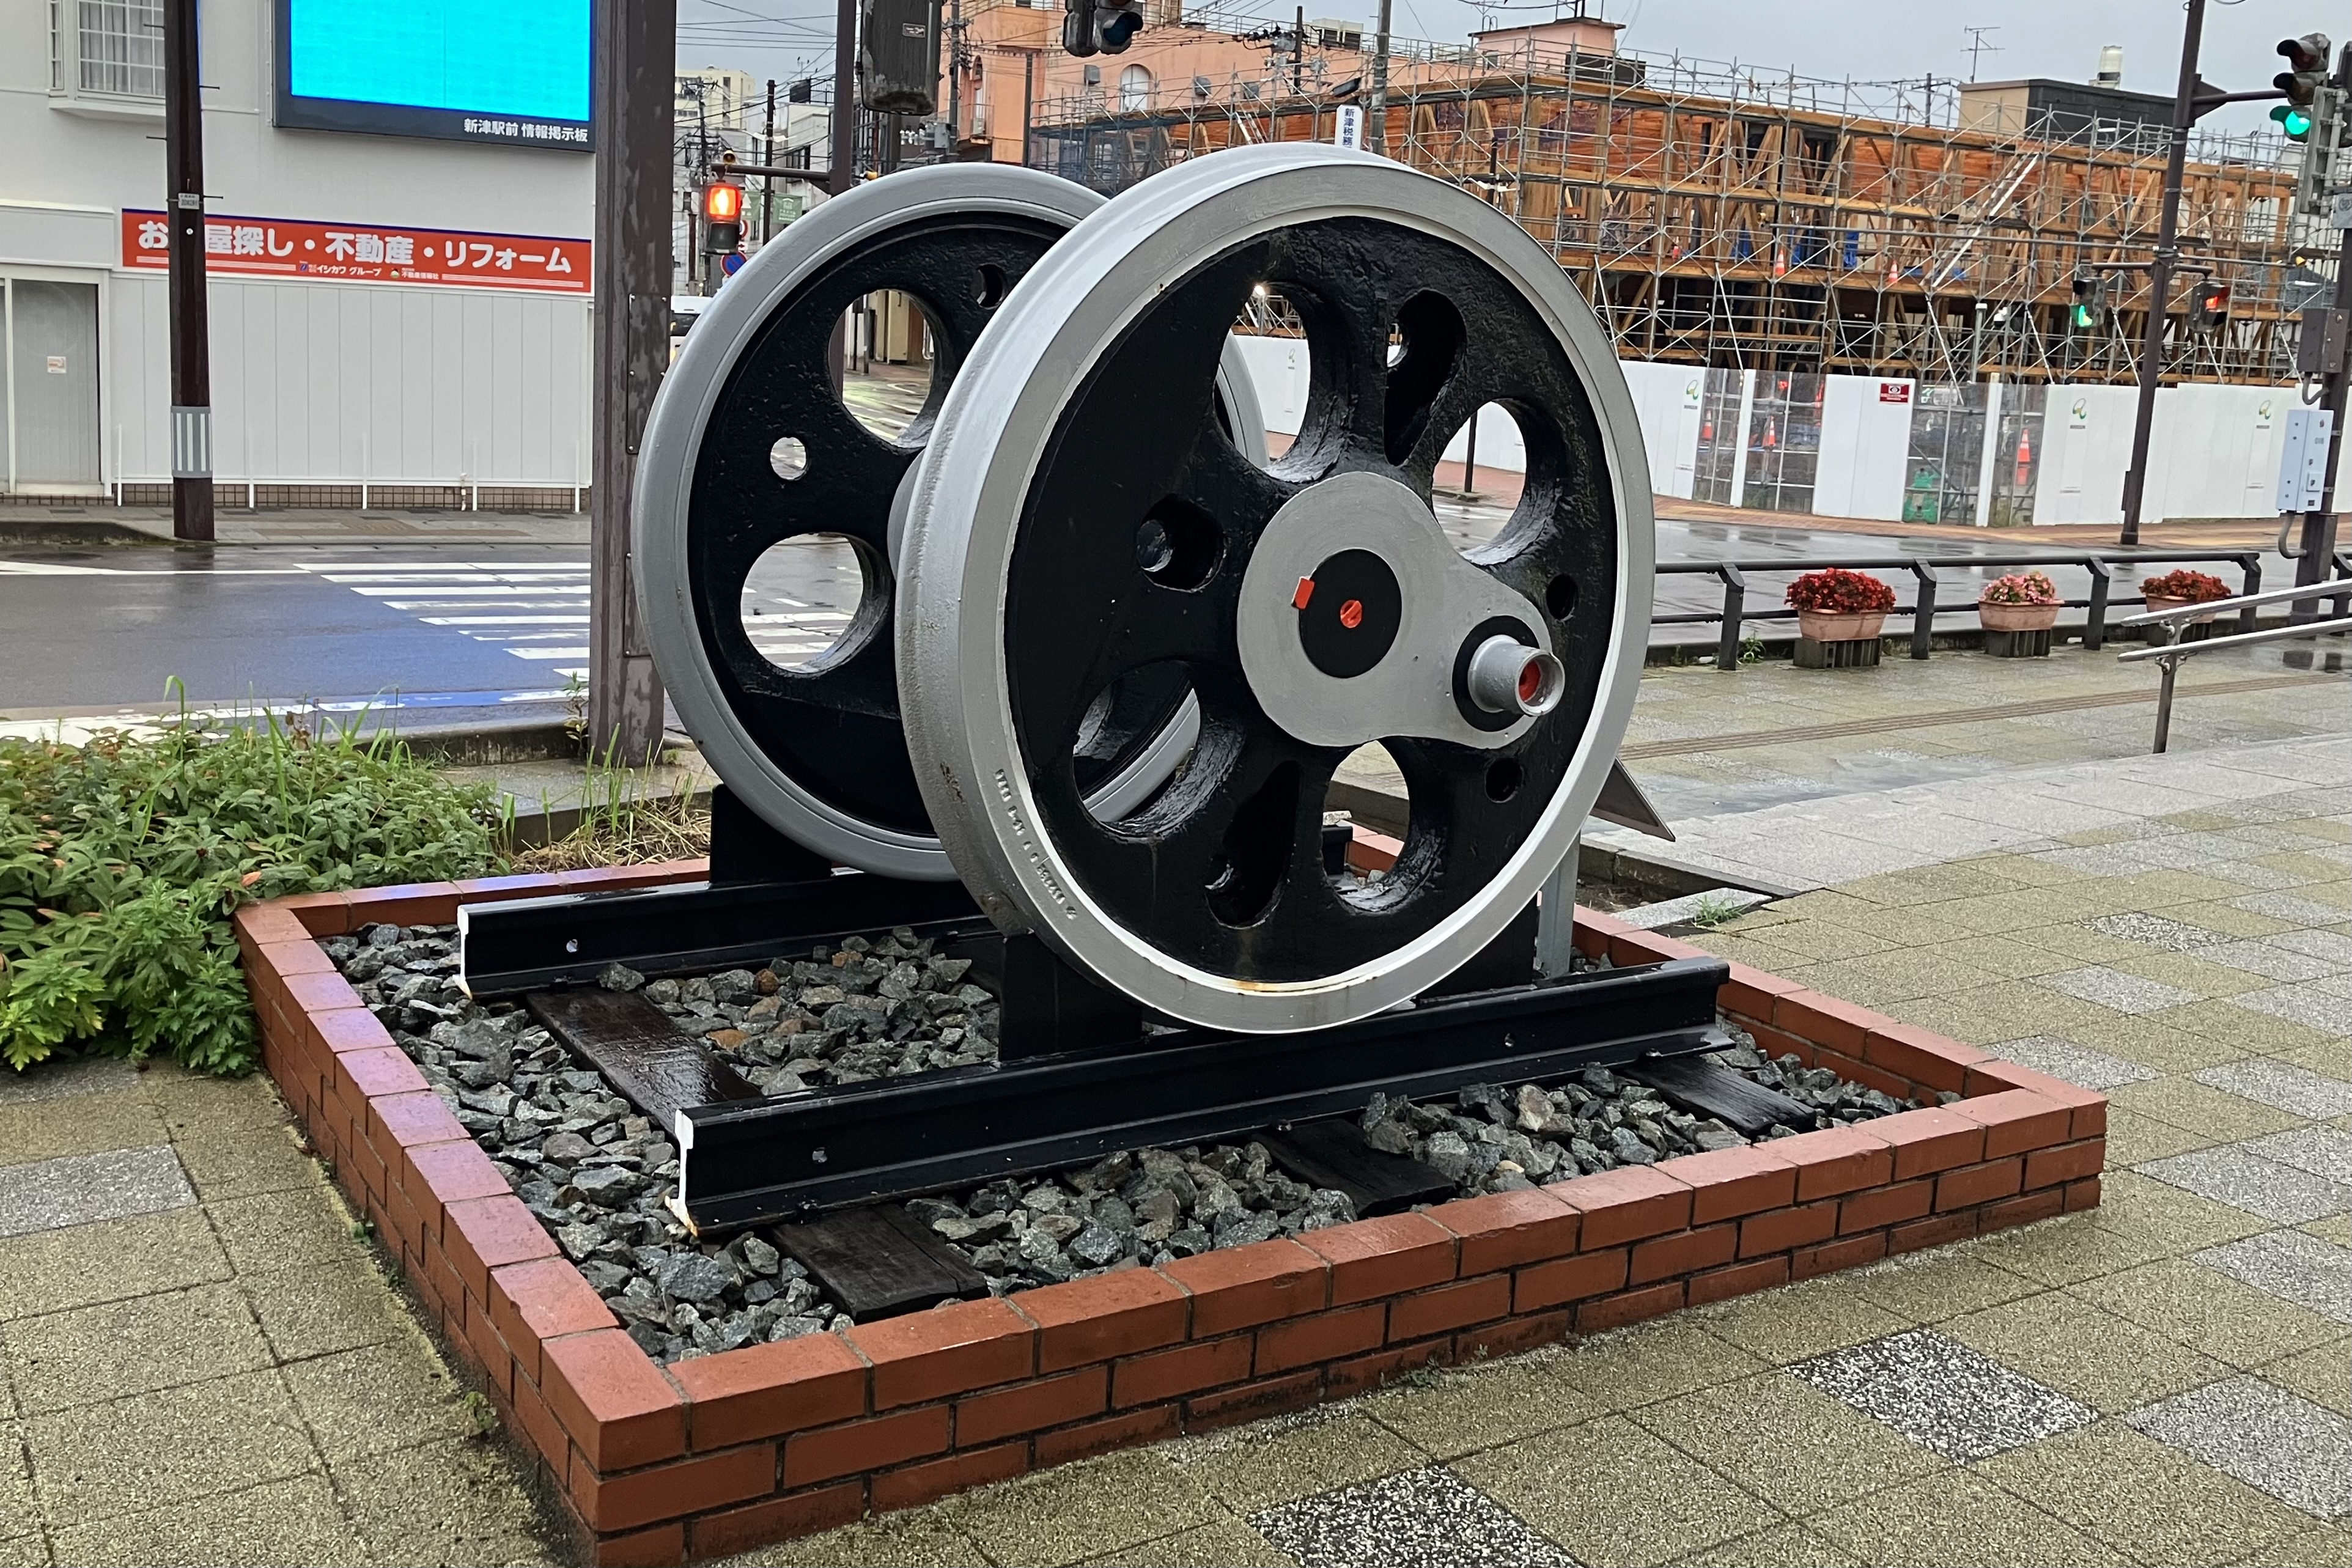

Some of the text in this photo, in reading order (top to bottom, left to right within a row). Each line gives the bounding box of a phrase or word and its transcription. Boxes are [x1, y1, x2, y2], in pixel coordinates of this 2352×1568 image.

[464, 118, 588, 142] 新津駅前 情報掲示板
[1342, 108, 1355, 148] 新津税務
[138, 221, 572, 273] お屋探し・不動産・リフォーム
[317, 265, 347, 274] イシカワ
[349, 268, 382, 276] グループ
